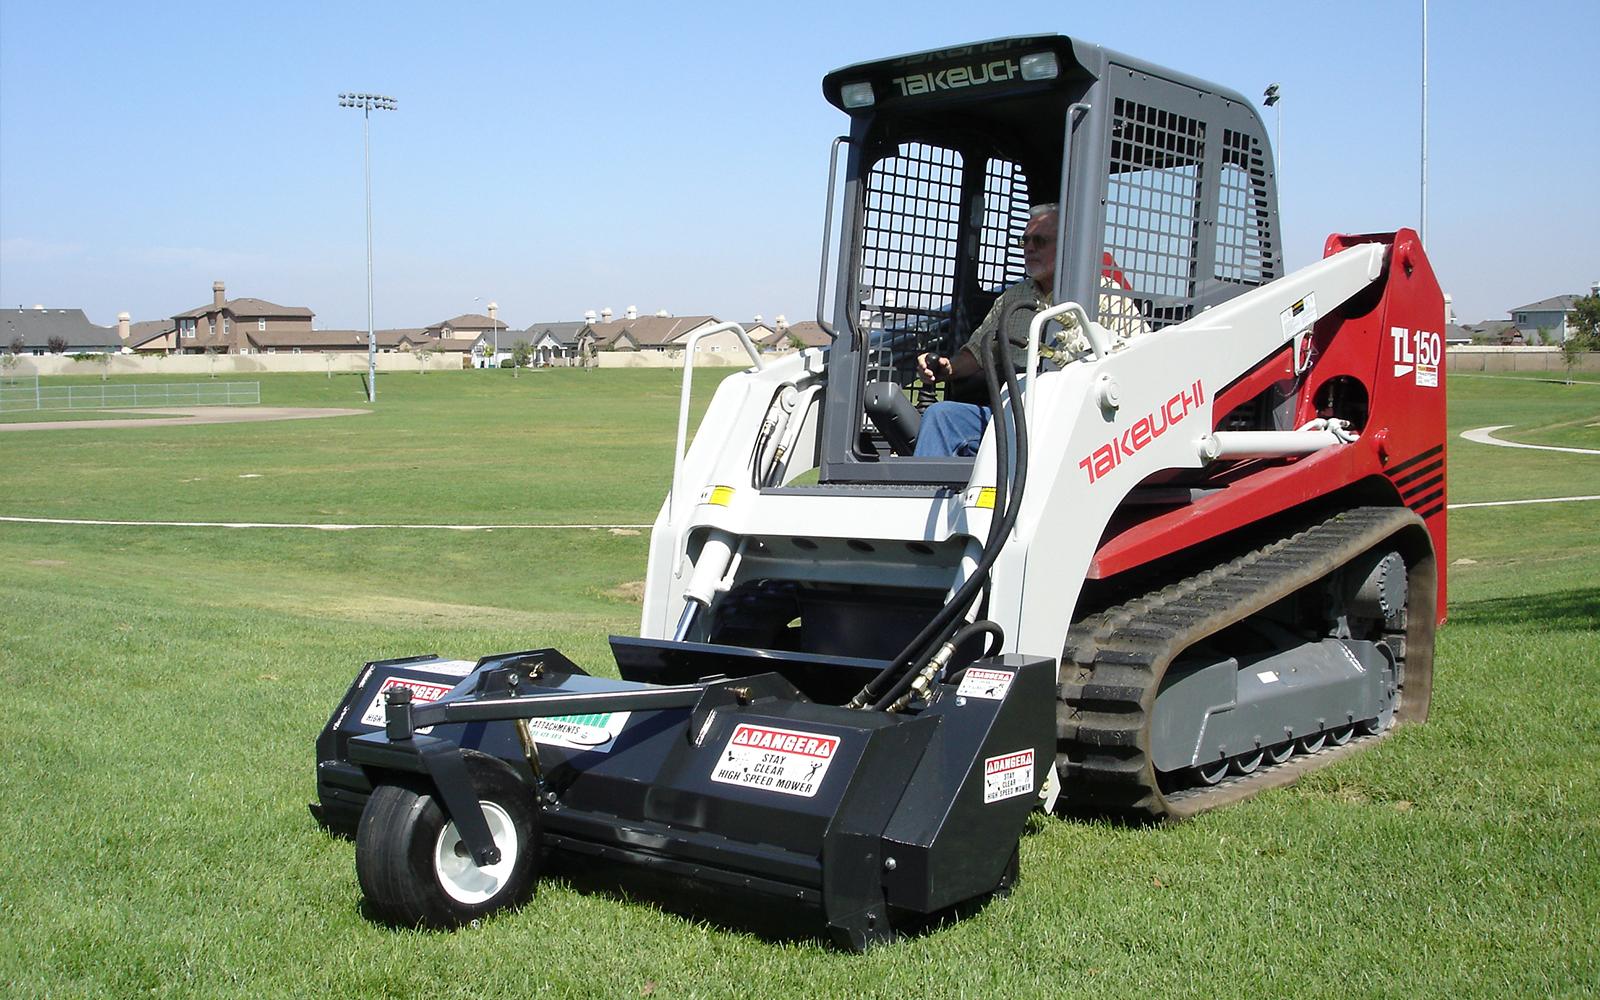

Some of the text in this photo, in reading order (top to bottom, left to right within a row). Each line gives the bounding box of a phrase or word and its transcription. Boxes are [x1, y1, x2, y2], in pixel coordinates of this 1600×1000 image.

[893, 59, 1019, 96] TAKEUCH
[1079, 379, 1204, 484] TAKEUCHI
[532, 720, 580, 735] ATTACHMENTS
[749, 730, 820, 754] DANGER
[762, 753, 786, 765] STAY
[994, 755, 1028, 771] DANGER
[754, 763, 784, 776] CLEAR
[1003, 772, 1015, 780] STAY
[718, 769, 813, 793] HIGH SPEED MOWER
[1002, 779, 1016, 788] CLEAR
[987, 783, 1031, 800] HIGH SPEED MOWER
